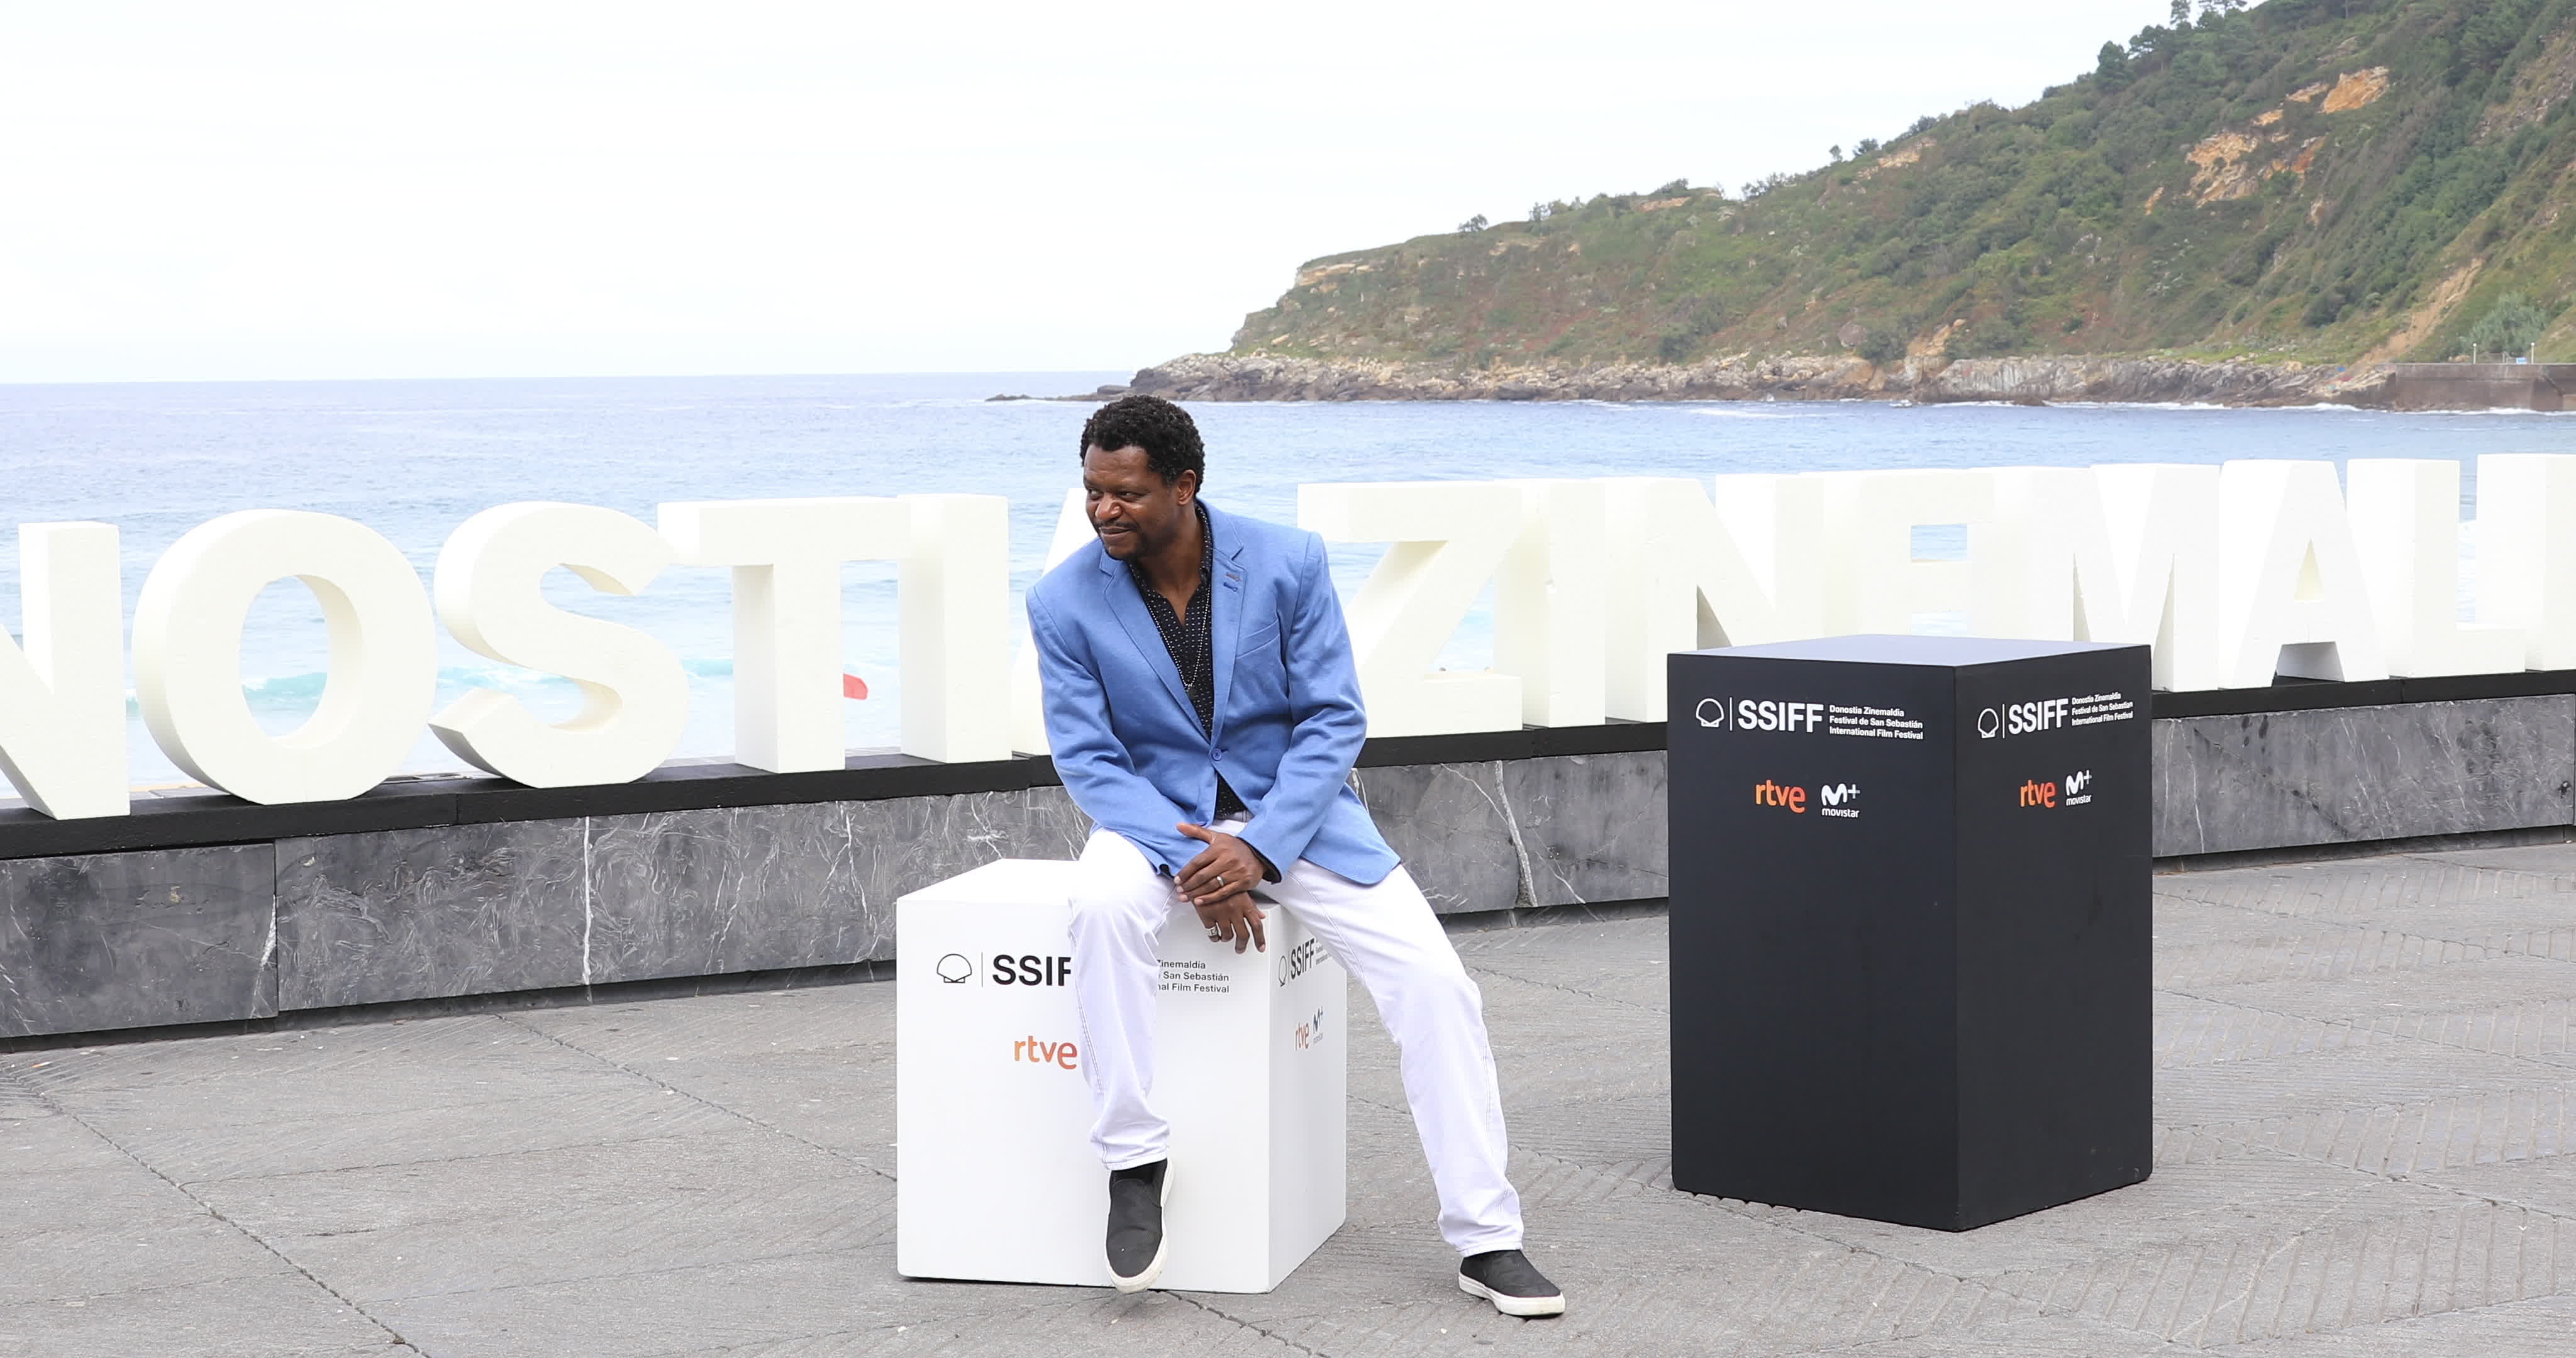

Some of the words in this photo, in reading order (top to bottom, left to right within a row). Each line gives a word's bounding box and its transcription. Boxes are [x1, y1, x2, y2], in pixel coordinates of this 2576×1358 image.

[1738, 699, 1824, 732] SSIFF
[1829, 705, 1862, 714] Donostia
[1863, 707, 1904, 717] Zinemaldia
[2008, 698, 2068, 734] SSIFF
[1829, 715, 1858, 724] Festival
[1859, 717, 1869, 726] de
[1870, 718, 1884, 726] San
[1886, 719, 1923, 729] Sebastián
[1829, 726, 1875, 737] International
[1877, 729, 1893, 737] Film
[1894, 730, 1923, 739] Festival
[1755, 780, 1806, 814] rtve
[2020, 780, 2056, 808] rtve
[2066, 795, 2092, 805] movistar
[1821, 808, 1860, 818] movistar
[1157, 959, 1206, 969] inemaldia
[1291, 937, 1315, 980] SSIFF
[1163, 971, 1180, 980] San
[1183, 972, 1230, 981] Sebastián
[1172, 983, 1191, 991] Film
[1194, 984, 1230, 993] Festival
[1295, 1022, 1310, 1051] rtve
[1014, 1035, 1077, 1070] rtve
